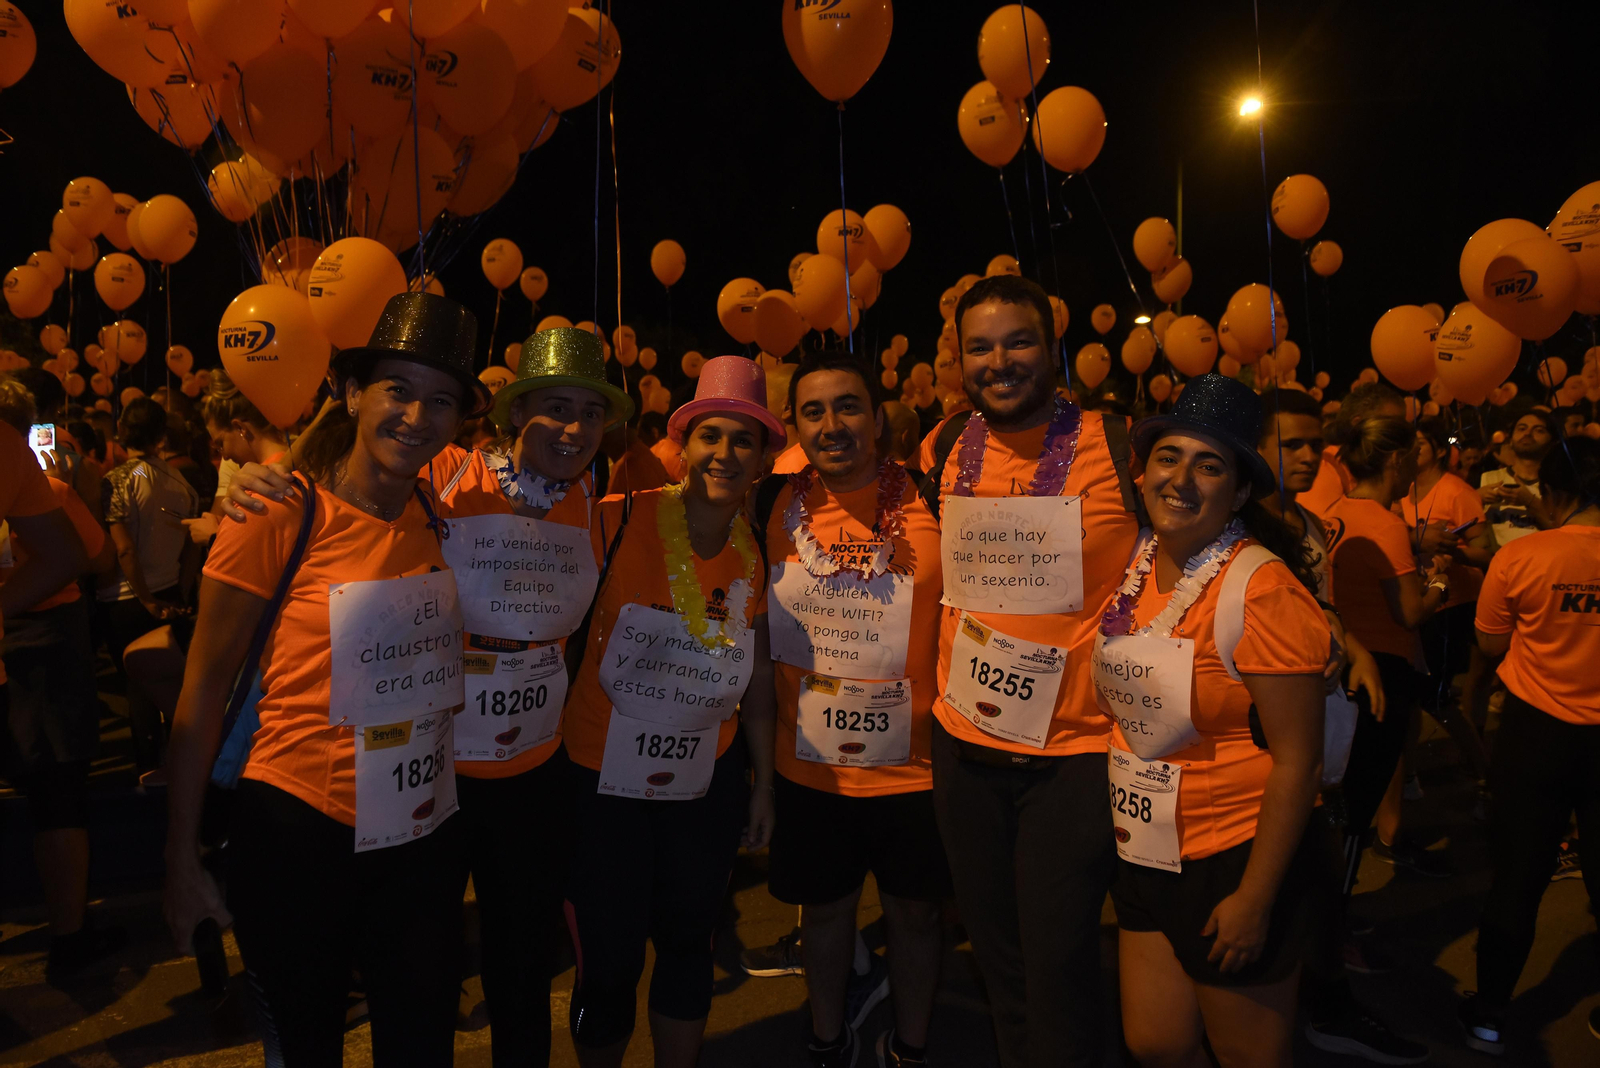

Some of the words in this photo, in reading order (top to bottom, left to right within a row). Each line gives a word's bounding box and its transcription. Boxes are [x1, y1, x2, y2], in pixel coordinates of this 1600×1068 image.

[818, 12, 851, 20] SEVILLA
[474, 537, 495, 550] He
[501, 539, 550, 552] venido
[554, 544, 574, 555] por
[960, 528, 974, 541] Lo
[978, 531, 1008, 545] que
[1014, 528, 1047, 545] hay
[471, 557, 555, 573] imposición
[560, 562, 580, 575] del
[953, 551, 974, 564] que
[978, 550, 1025, 564] hacer
[1031, 553, 1061, 567] por
[504, 579, 554, 596] Equipo
[960, 574, 976, 585] un
[981, 573, 1051, 587] sexenio.
[804, 584, 869, 600] ¿Alguien
[413, 599, 440, 626] ¿El
[490, 600, 563, 614] Directivo.
[792, 601, 836, 617] quiere
[842, 607, 884, 622] WIFI?
[622, 626, 659, 648] Soy
[794, 618, 810, 633] Yo
[813, 625, 860, 642] pongo
[865, 629, 880, 642] la
[360, 627, 451, 664] claustro
[808, 645, 860, 661] antena
[616, 653, 629, 669] y
[635, 657, 722, 684] currando
[728, 674, 739, 687] a
[970, 656, 1036, 701] 18255
[1101, 660, 1155, 681] mejor
[375, 674, 414, 695] era
[613, 679, 667, 700] estas
[673, 687, 726, 709] horas.
[475, 684, 548, 716] 18260
[1103, 686, 1134, 706] esto
[1142, 695, 1163, 710] es
[823, 707, 890, 732] 18253
[635, 733, 701, 760] 18257
[392, 744, 445, 792] 18256
[1110, 782, 1152, 824] 8258
